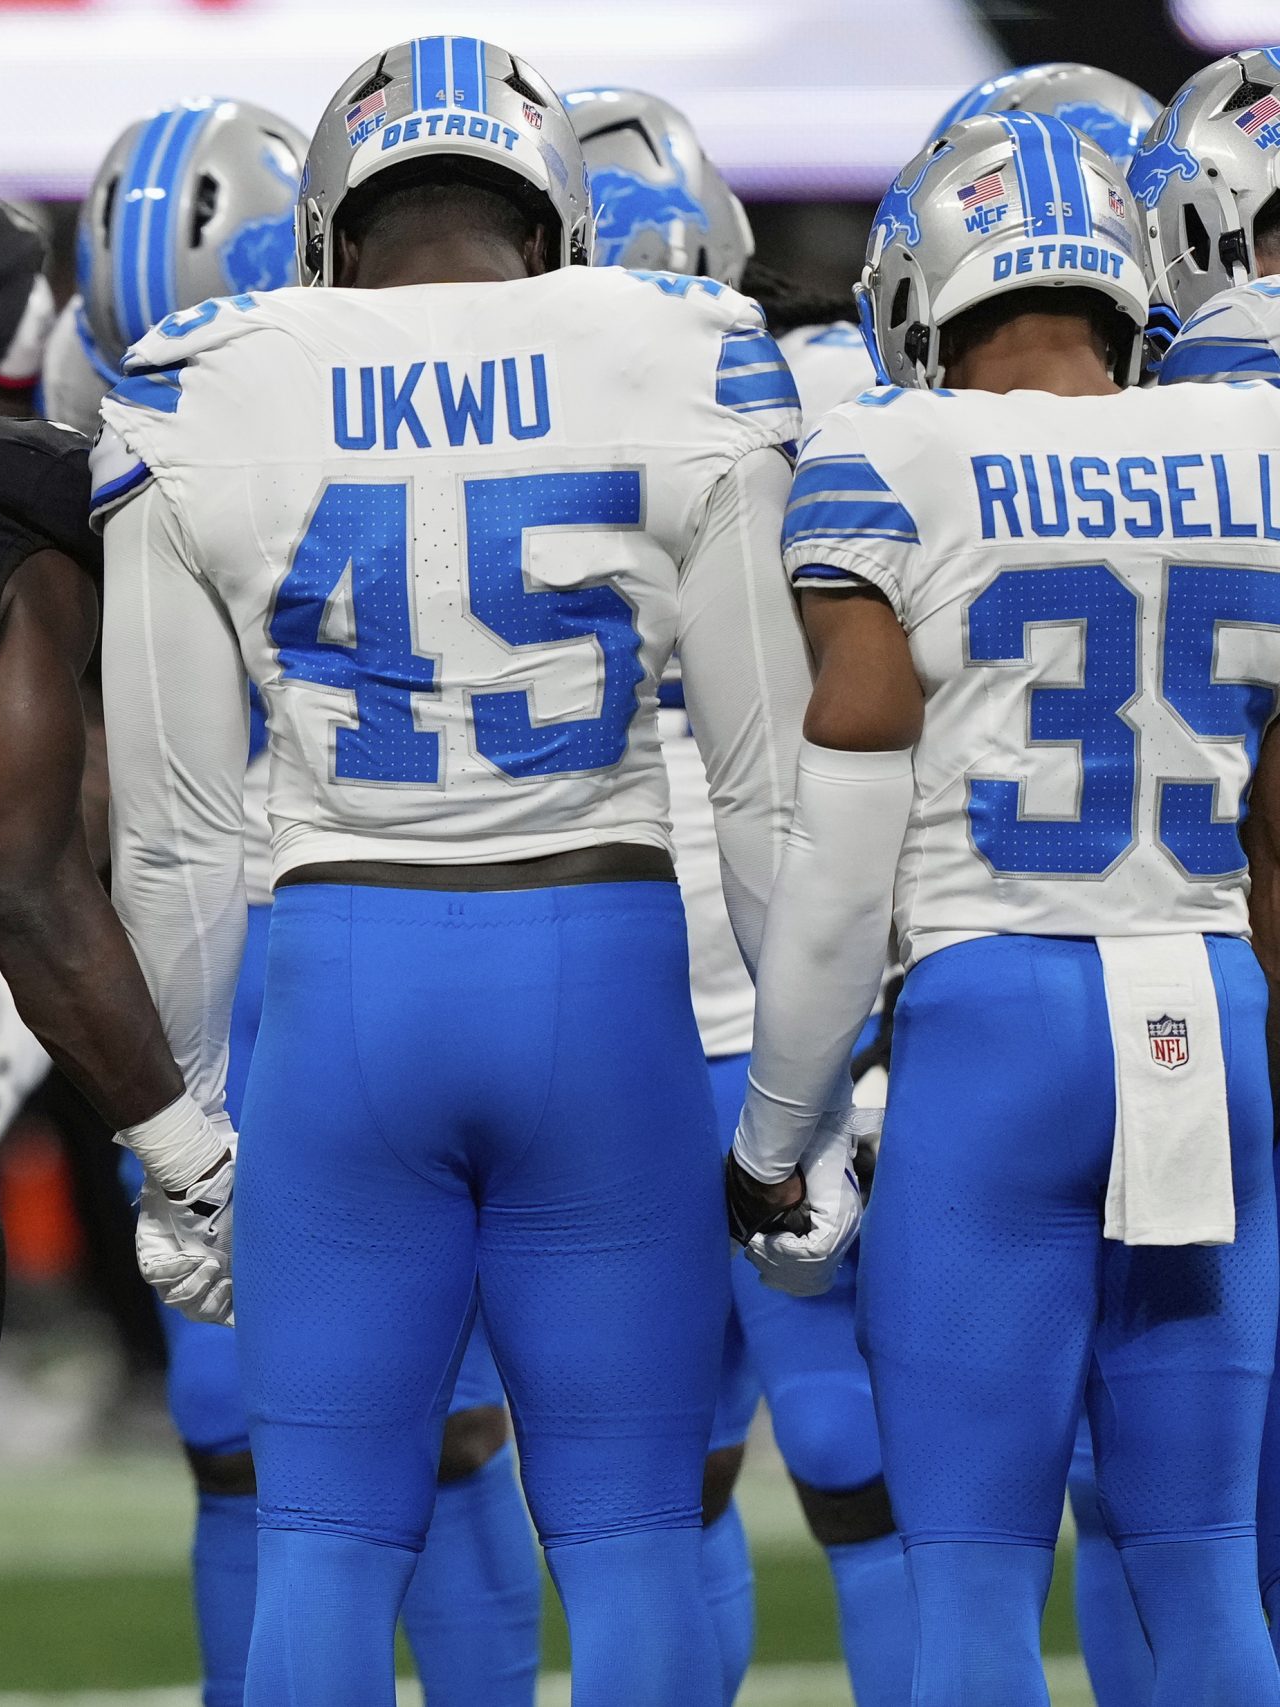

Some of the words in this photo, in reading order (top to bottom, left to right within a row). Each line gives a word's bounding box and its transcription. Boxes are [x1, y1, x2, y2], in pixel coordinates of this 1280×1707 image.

[435, 89, 464, 101] 45
[349, 111, 388, 148] WCF
[381, 114, 519, 151] DETROIT
[964, 203, 1009, 235] WCF
[1045, 202, 1073, 217] 35
[993, 243, 1124, 282] DETROIT
[332, 353, 551, 451] UKWU
[264, 463, 648, 791] 45
[960, 557, 1280, 883] 35
[1153, 1038, 1185, 1064] NFL
